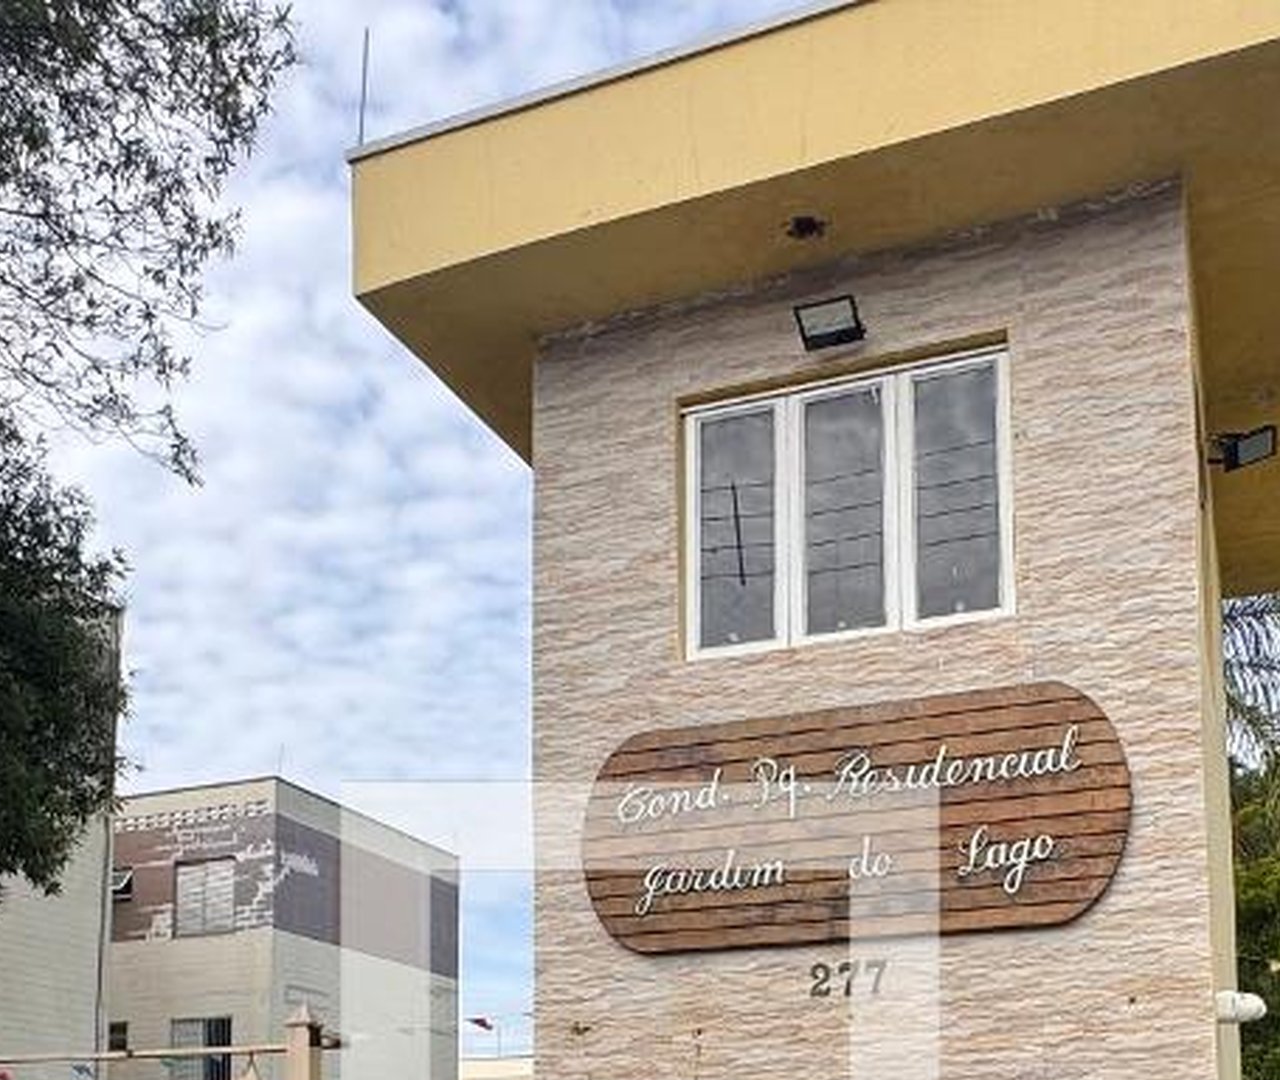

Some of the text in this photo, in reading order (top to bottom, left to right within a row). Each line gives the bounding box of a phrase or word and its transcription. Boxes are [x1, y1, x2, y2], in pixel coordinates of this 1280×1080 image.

[825, 725, 1082, 800] Residencial
[849, 835, 893, 879] do
[957, 824, 1055, 894] Lago
[809, 960, 887, 997] 277
